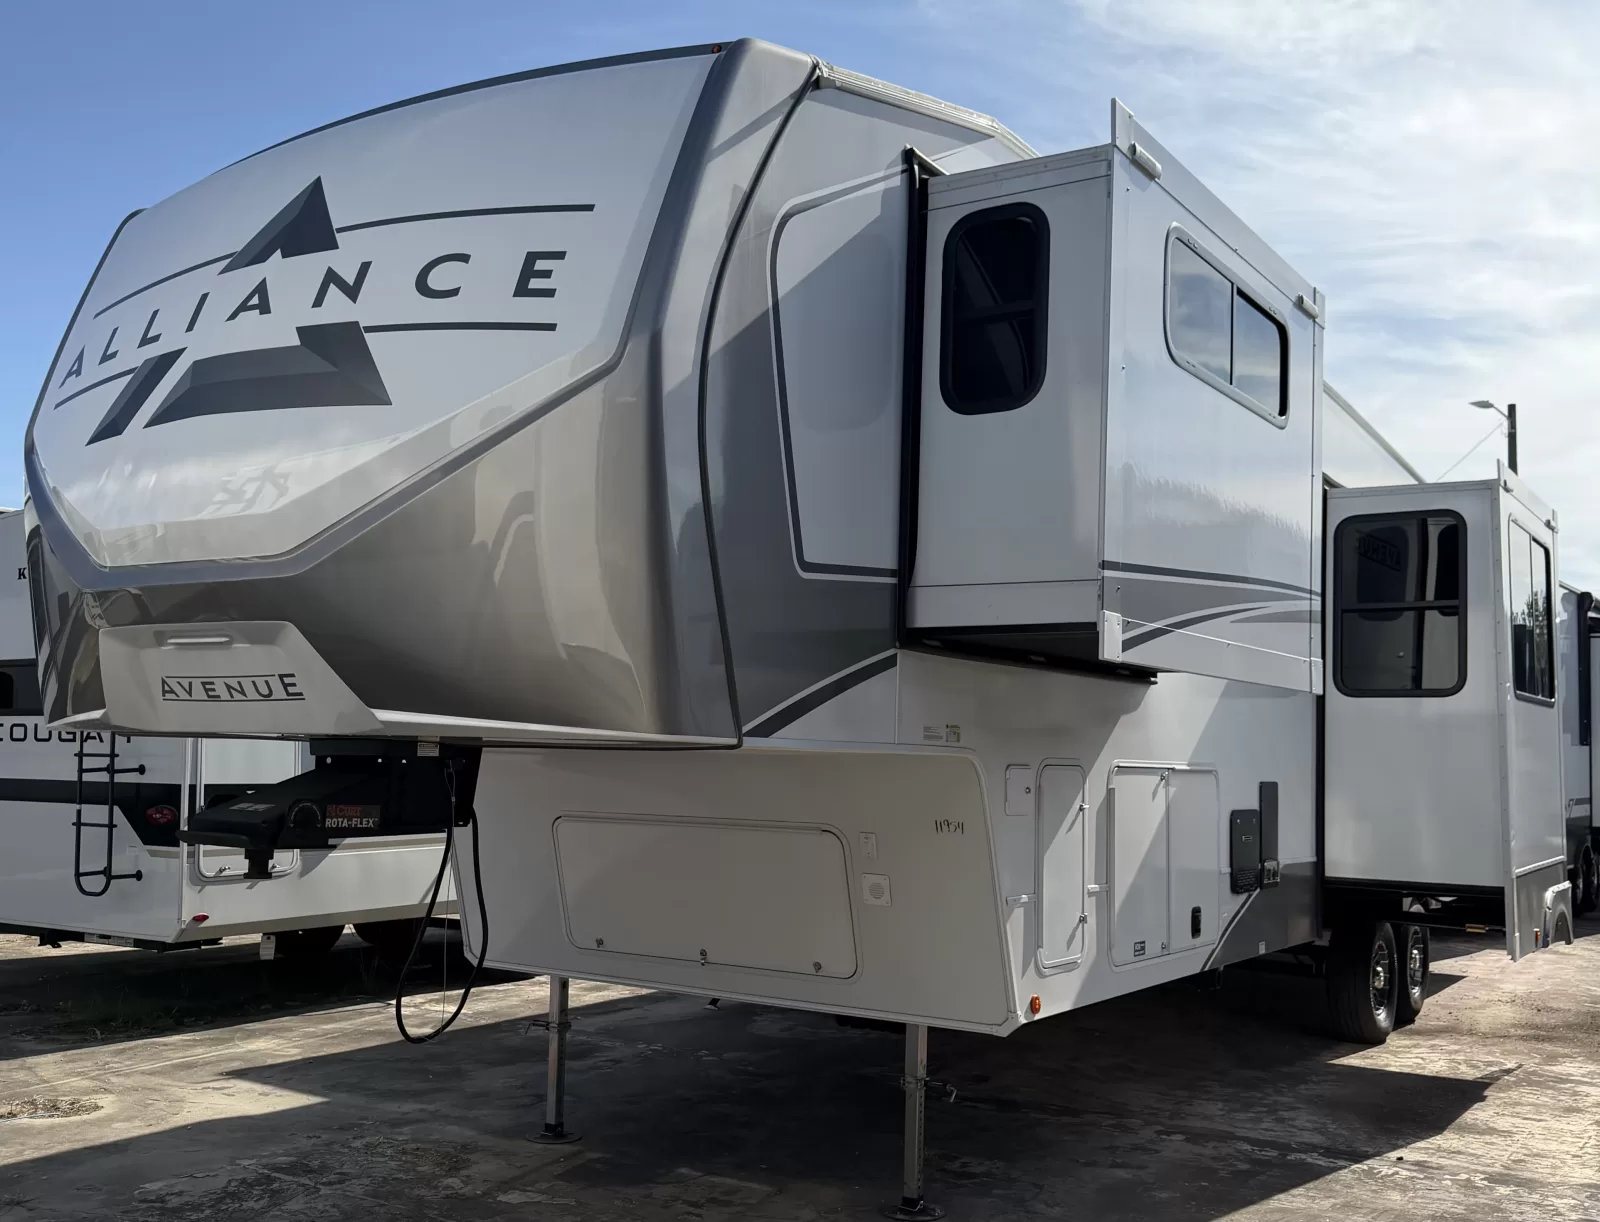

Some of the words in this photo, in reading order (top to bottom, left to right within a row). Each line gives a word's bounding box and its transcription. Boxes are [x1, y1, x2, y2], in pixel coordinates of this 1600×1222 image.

[59, 250, 566, 387] ALLIANCE
[161, 673, 305, 698] AVENUE
[935, 819, 964, 835] 11954
